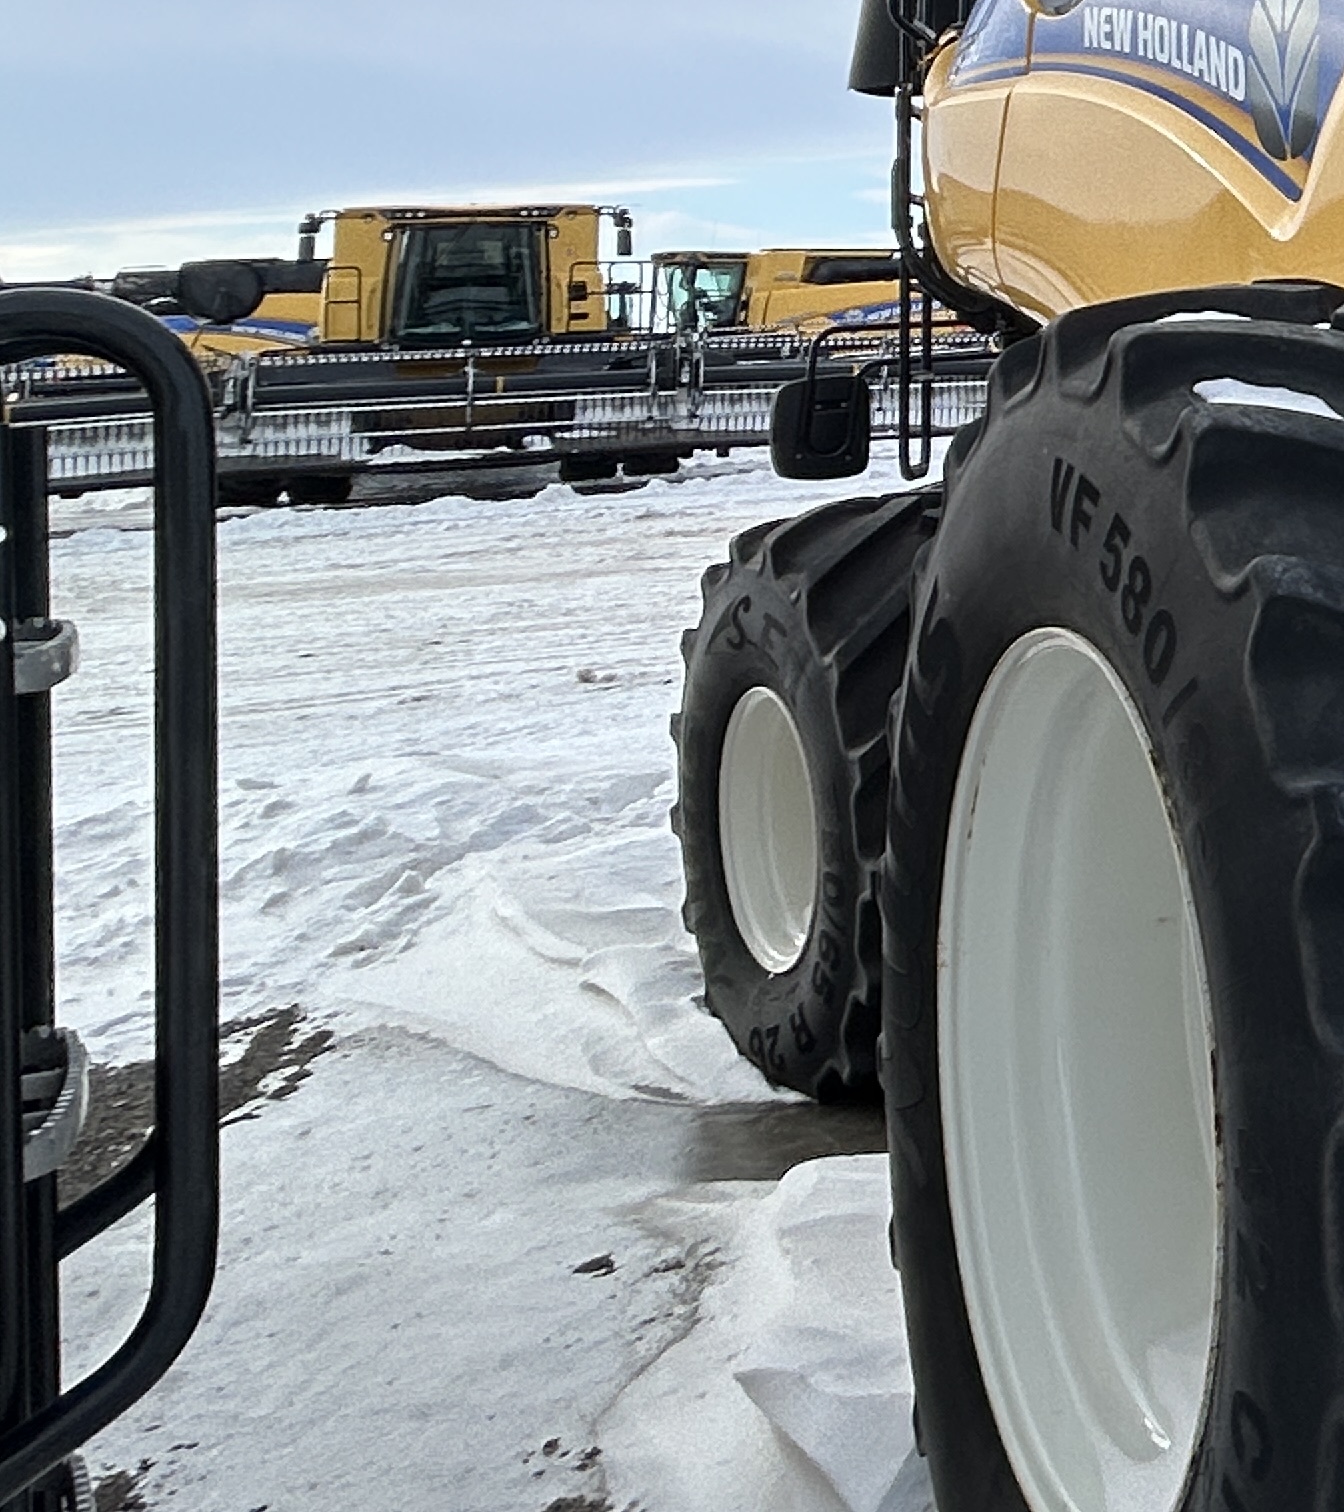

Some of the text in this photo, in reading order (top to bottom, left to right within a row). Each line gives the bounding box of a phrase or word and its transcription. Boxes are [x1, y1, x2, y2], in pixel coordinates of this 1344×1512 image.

[1084, 6, 1246, 101] NEW HOLLAND
[1051, 457, 1101, 551] VF
